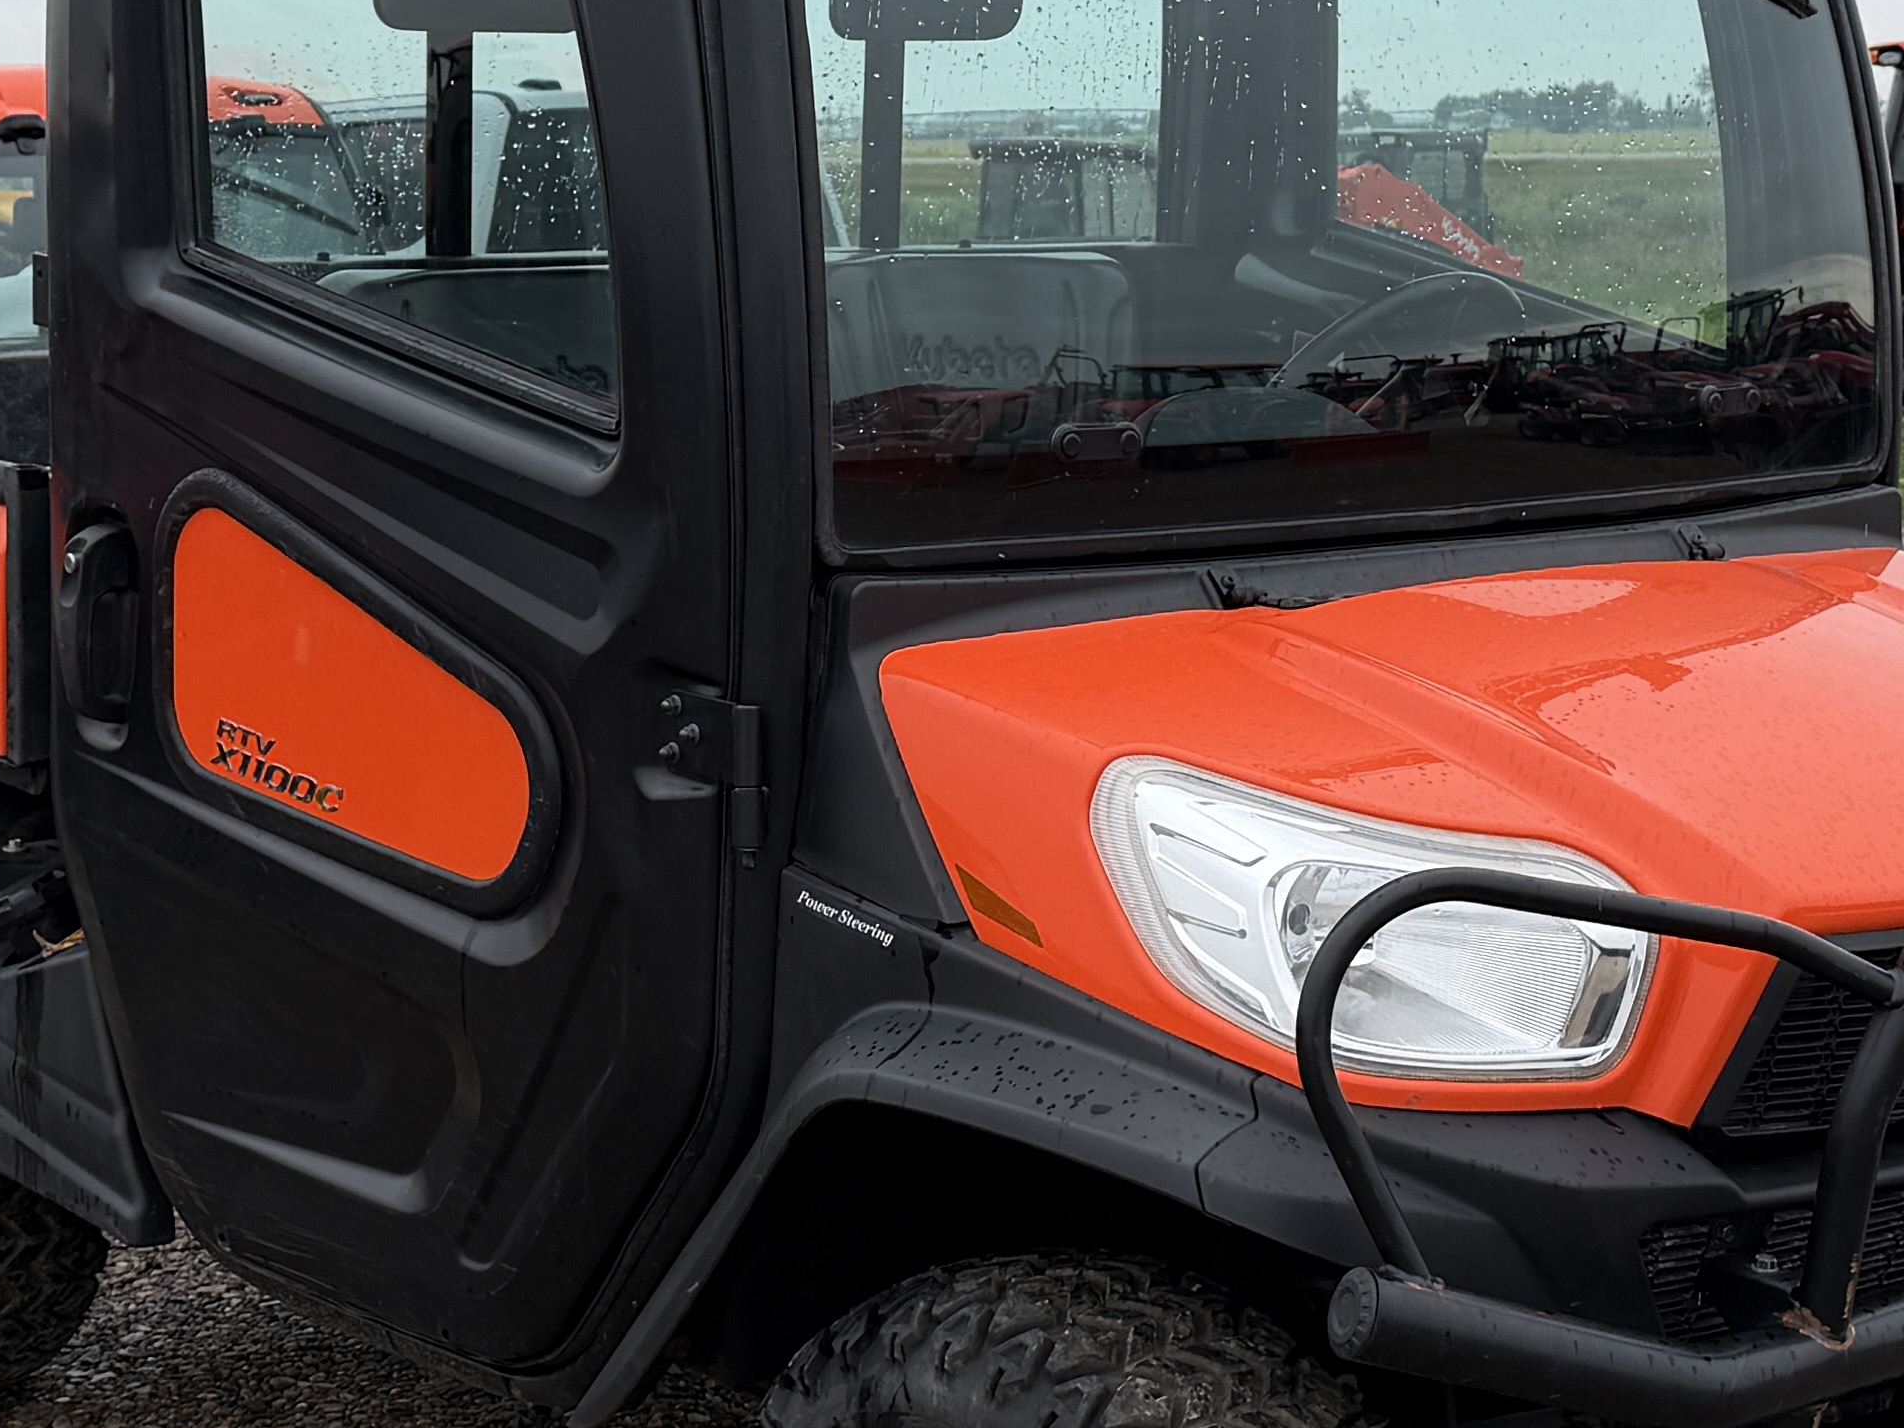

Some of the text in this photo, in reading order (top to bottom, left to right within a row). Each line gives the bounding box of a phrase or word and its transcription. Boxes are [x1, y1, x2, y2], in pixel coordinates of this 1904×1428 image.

[216, 716, 276, 757] RTV
[210, 739, 345, 813] X1100C
[797, 890, 895, 948] Power Steering
